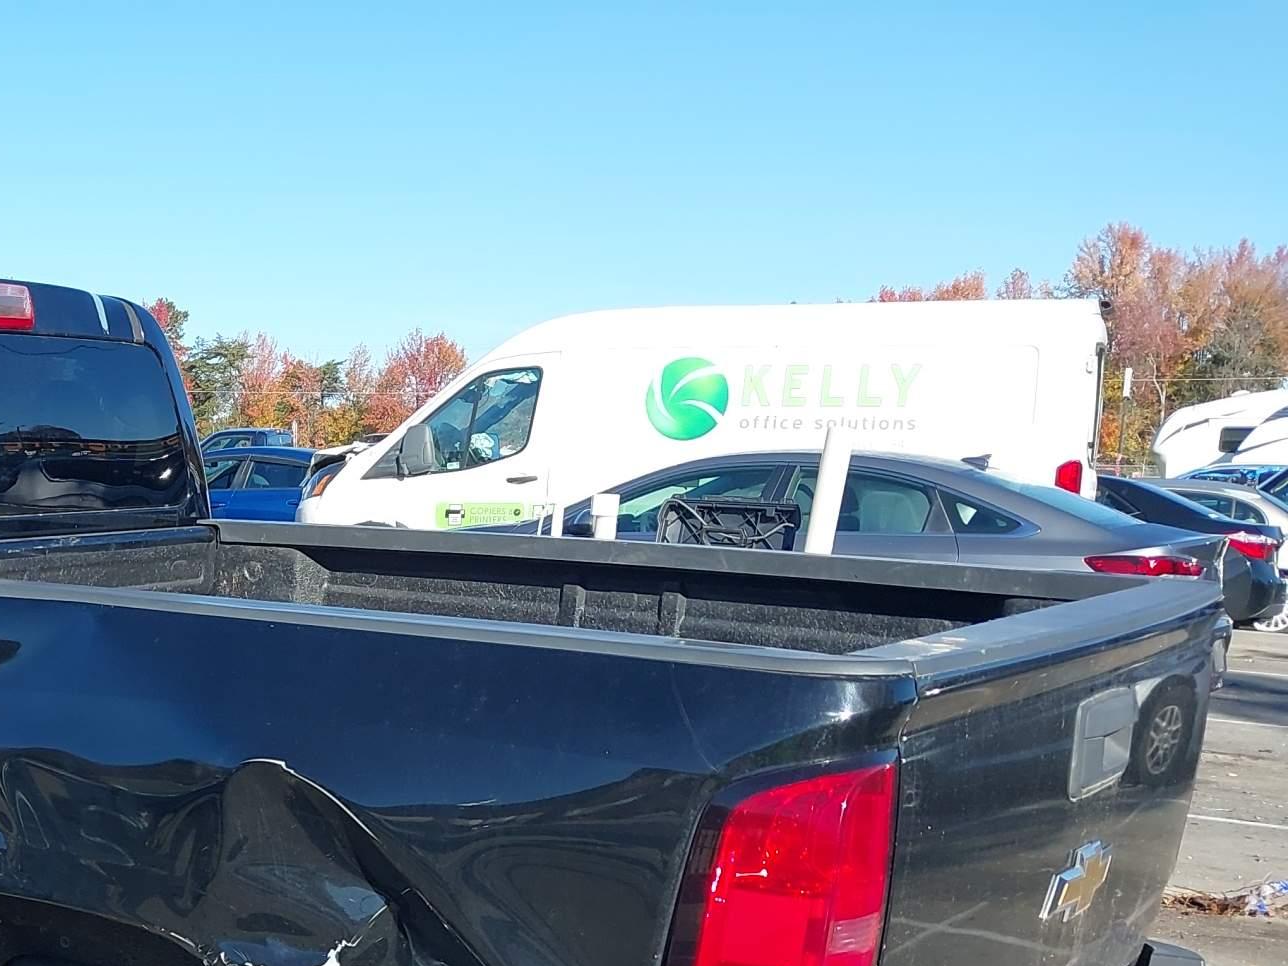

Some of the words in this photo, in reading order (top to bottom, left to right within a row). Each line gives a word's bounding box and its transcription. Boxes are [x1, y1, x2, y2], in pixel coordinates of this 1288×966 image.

[740, 363, 923, 408] KELLY
[739, 415, 803, 430] office
[814, 416, 917, 431] solutions
